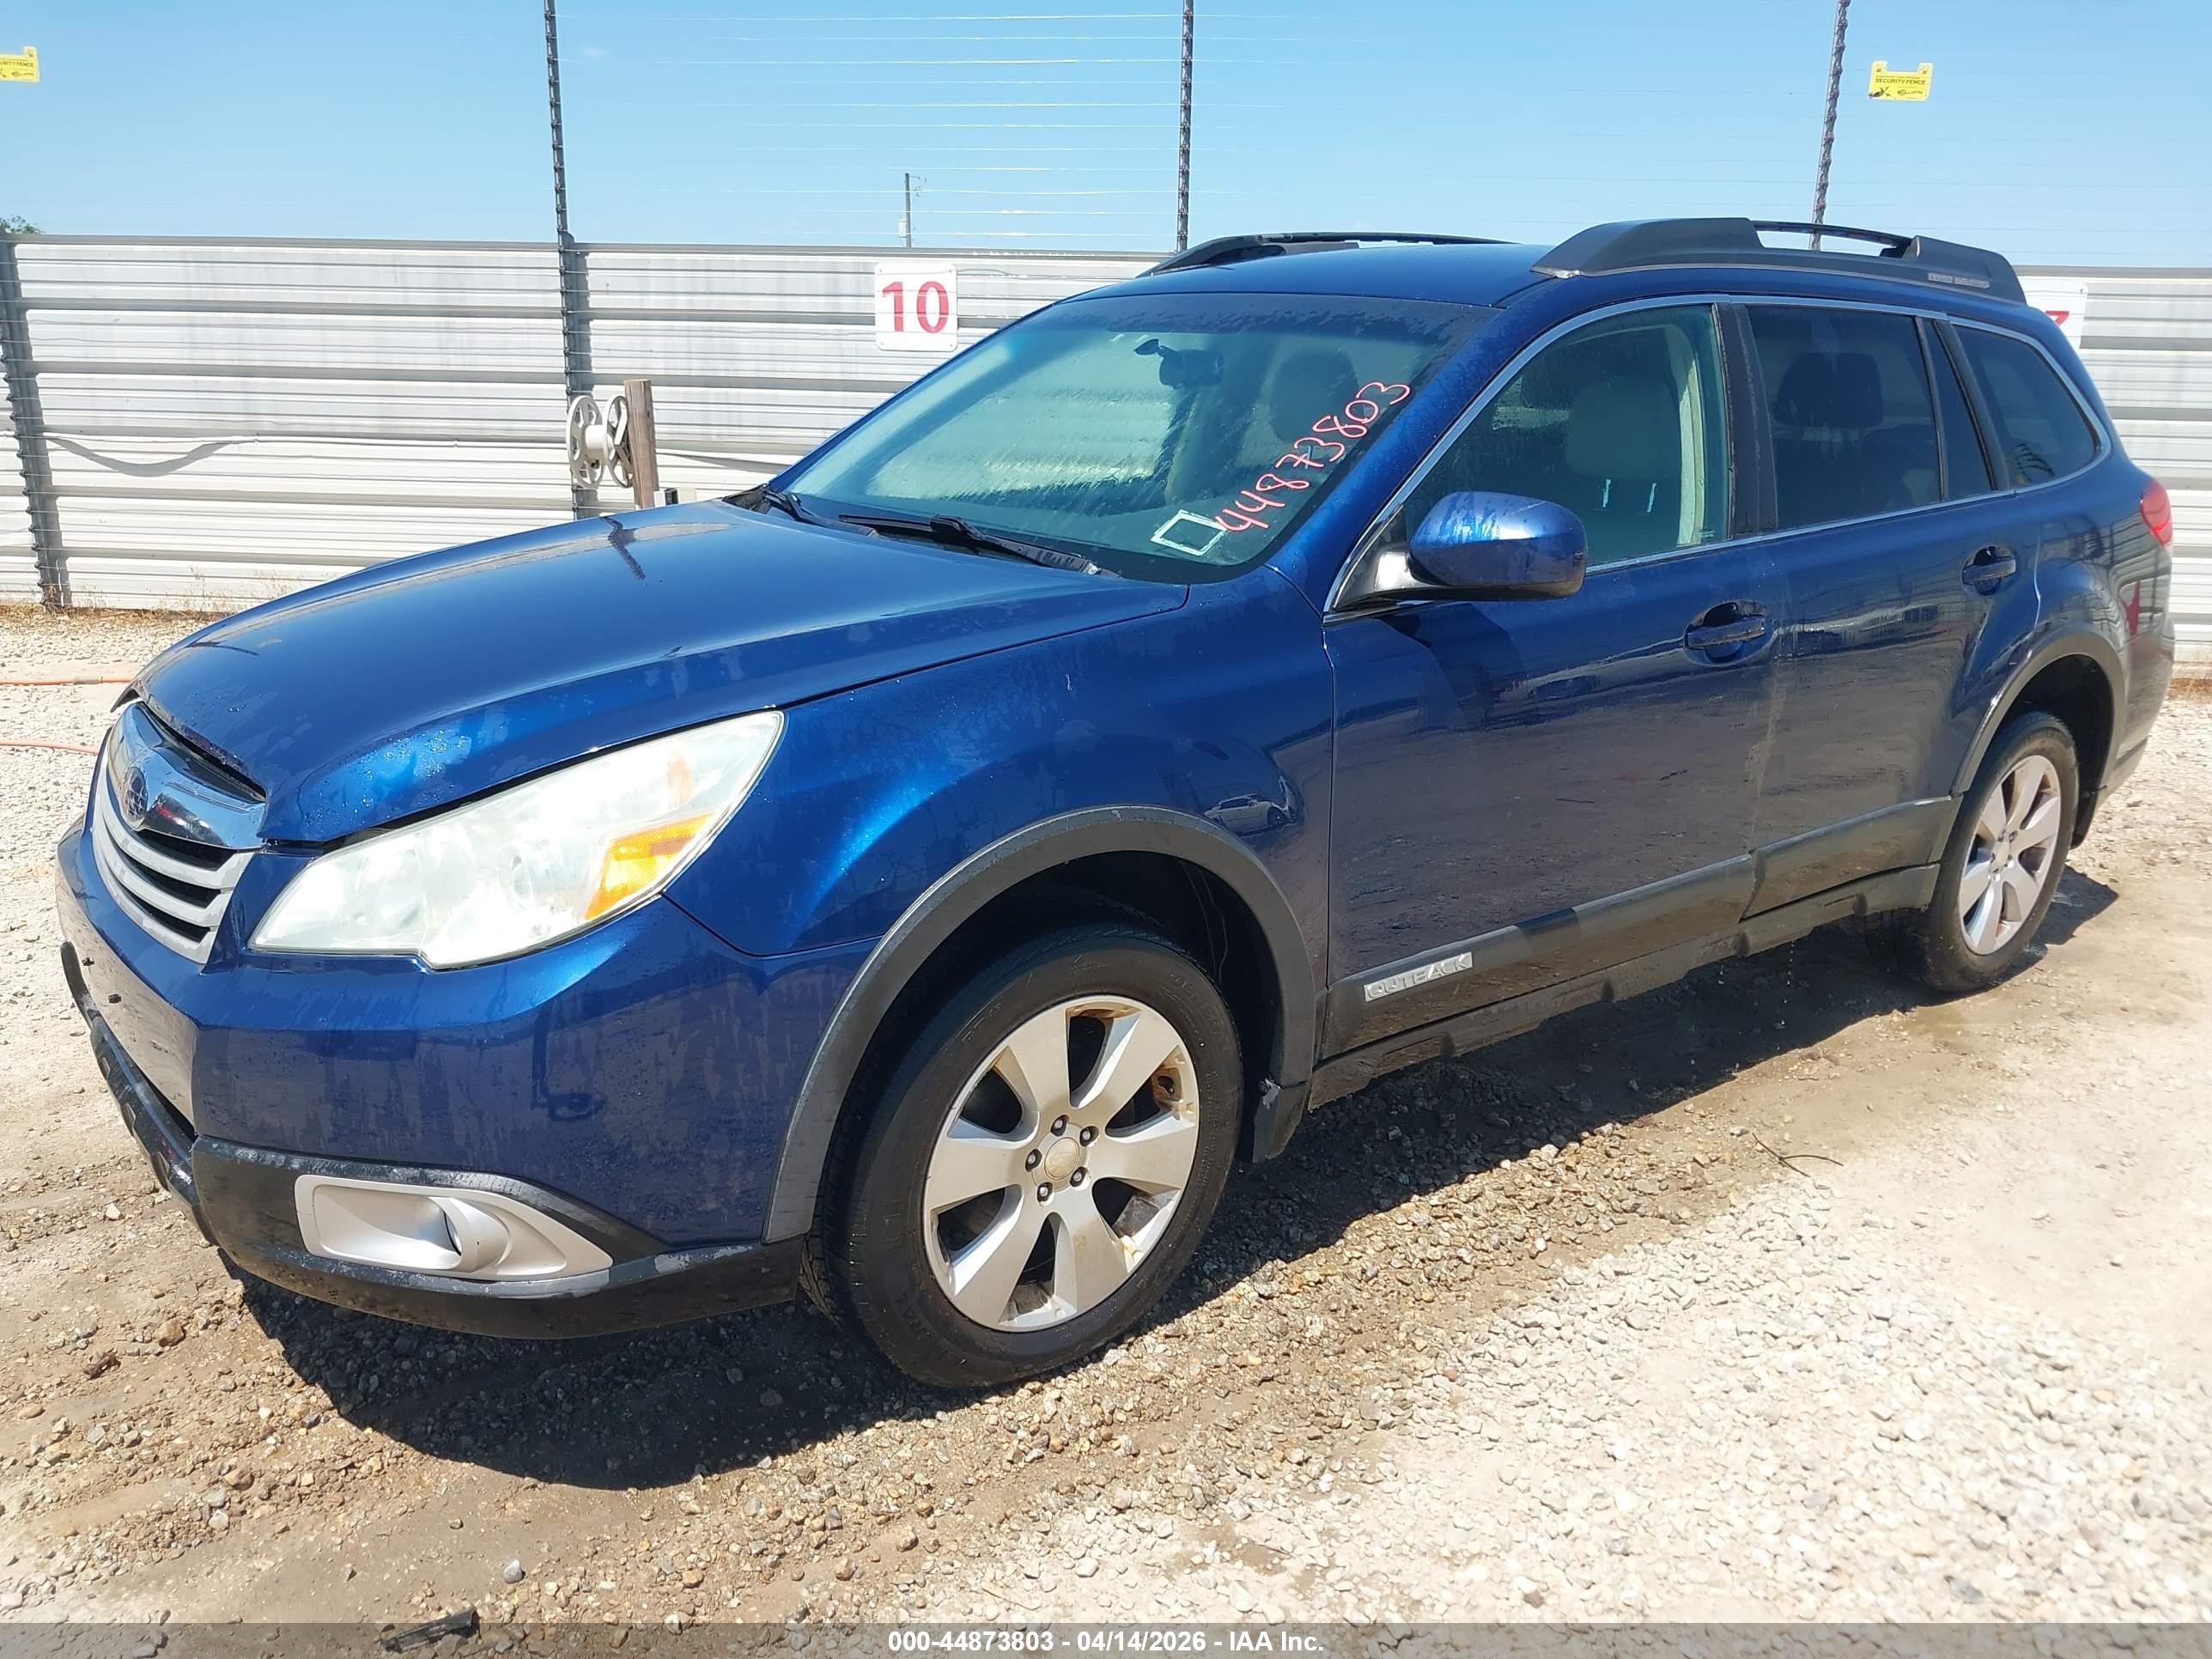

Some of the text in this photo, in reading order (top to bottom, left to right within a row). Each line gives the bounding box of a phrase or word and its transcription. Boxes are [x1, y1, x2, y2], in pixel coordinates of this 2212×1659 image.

[882, 281, 949, 334] 10
[1213, 381, 1411, 532] 44873803
[1365, 952, 1469, 999] OUTBACK
